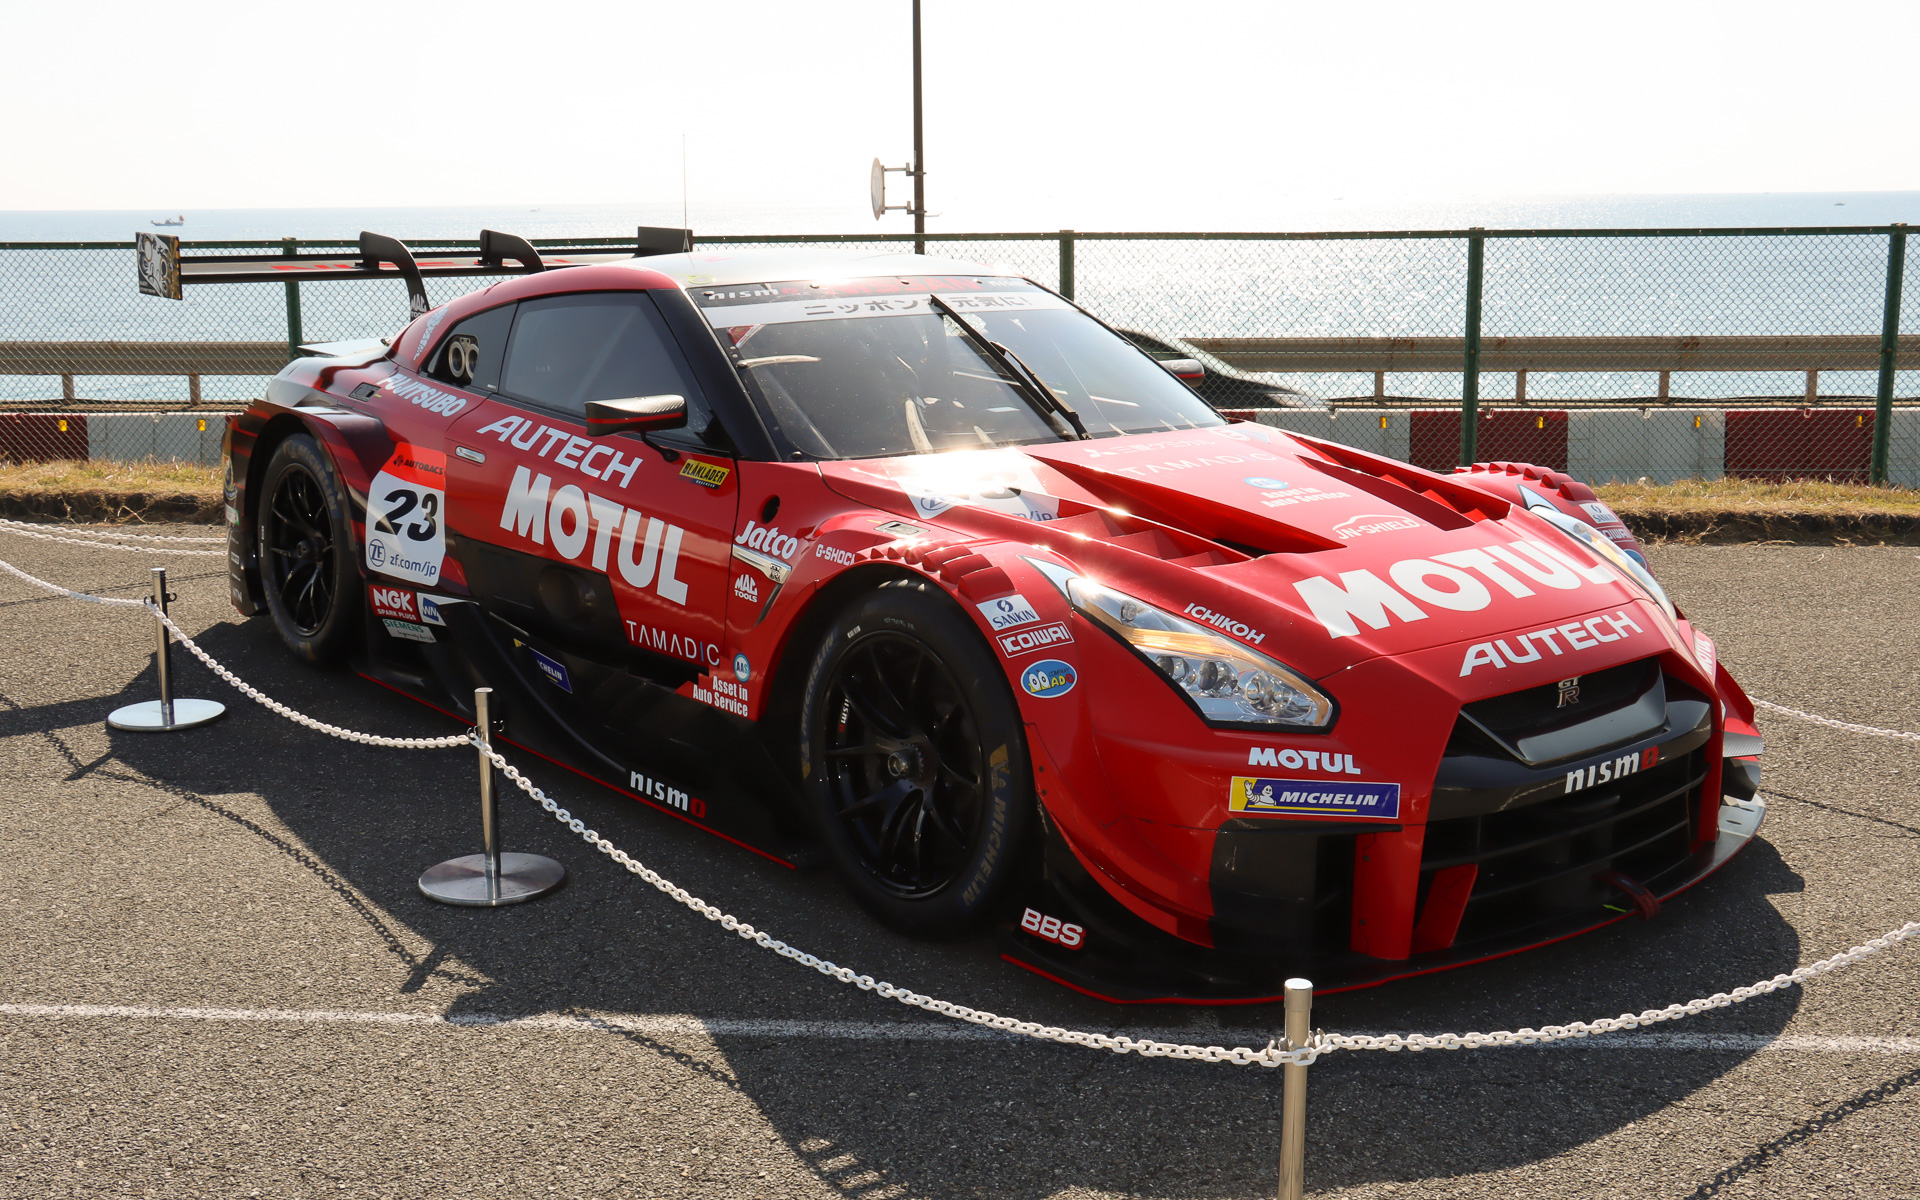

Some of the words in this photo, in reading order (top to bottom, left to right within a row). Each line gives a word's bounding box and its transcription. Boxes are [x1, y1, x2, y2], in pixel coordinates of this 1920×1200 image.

[376, 372, 467, 417] FUJITSUBO
[403, 458, 444, 476] AUTOBACS
[476, 415, 643, 489] AUTECH
[374, 489, 438, 541] 23
[1338, 518, 1421, 540] JN-SHIELD
[500, 465, 689, 606] MOTUL
[735, 520, 798, 560] Jatco
[389, 554, 437, 577] zf.com/jp
[373, 588, 414, 613] NGK
[734, 573, 758, 596] MAC
[734, 589, 758, 603] TOOLS
[1291, 540, 1619, 639] MOTUL
[384, 619, 425, 634] SIEMENS
[992, 609, 1035, 628] SANKIN
[1183, 602, 1266, 645] ICHIKOH
[626, 619, 720, 666] TAMADIC
[1459, 610, 1643, 678] AUTECH
[693, 684, 713, 705] Auto
[714, 690, 748, 717] Service
[712, 675, 737, 697] Asset
[738, 685, 748, 701] in
[1248, 747, 1361, 775] MOTUL
[1564, 746, 1658, 794] nismo
[630, 770, 707, 819] nismo
[1280, 791, 1380, 807] MICHELIN
[1021, 907, 1084, 949] BBS
